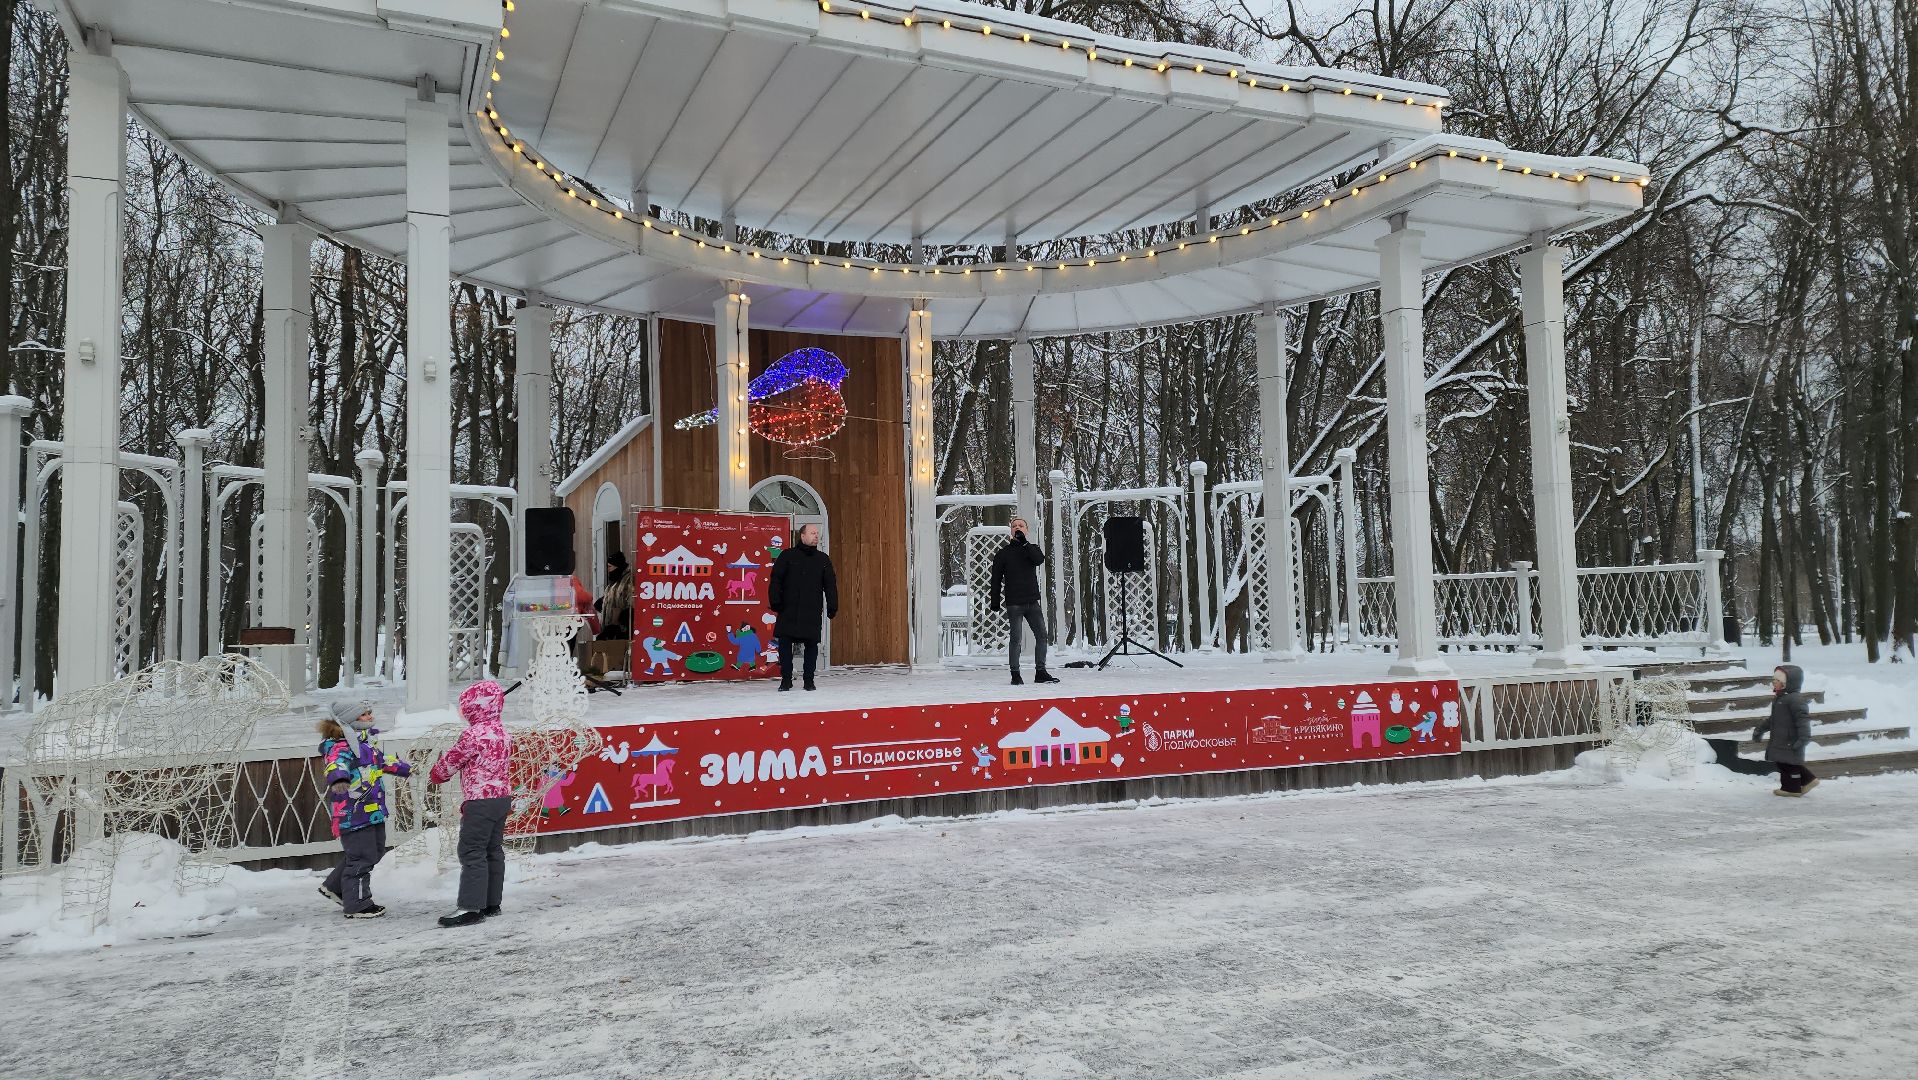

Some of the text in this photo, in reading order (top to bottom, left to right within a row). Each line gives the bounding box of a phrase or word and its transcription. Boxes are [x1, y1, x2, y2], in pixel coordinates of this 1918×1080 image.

[640, 581, 715, 600] ЗИМА
[1163, 729, 1195, 740] ПАРКИ
[1294, 723, 1344, 735] КРИВЯКИНО
[1163, 737, 1237, 751] ПОДМОСКОВЬЯ
[700, 746, 962, 787] ЗИМА в Подмосковье
